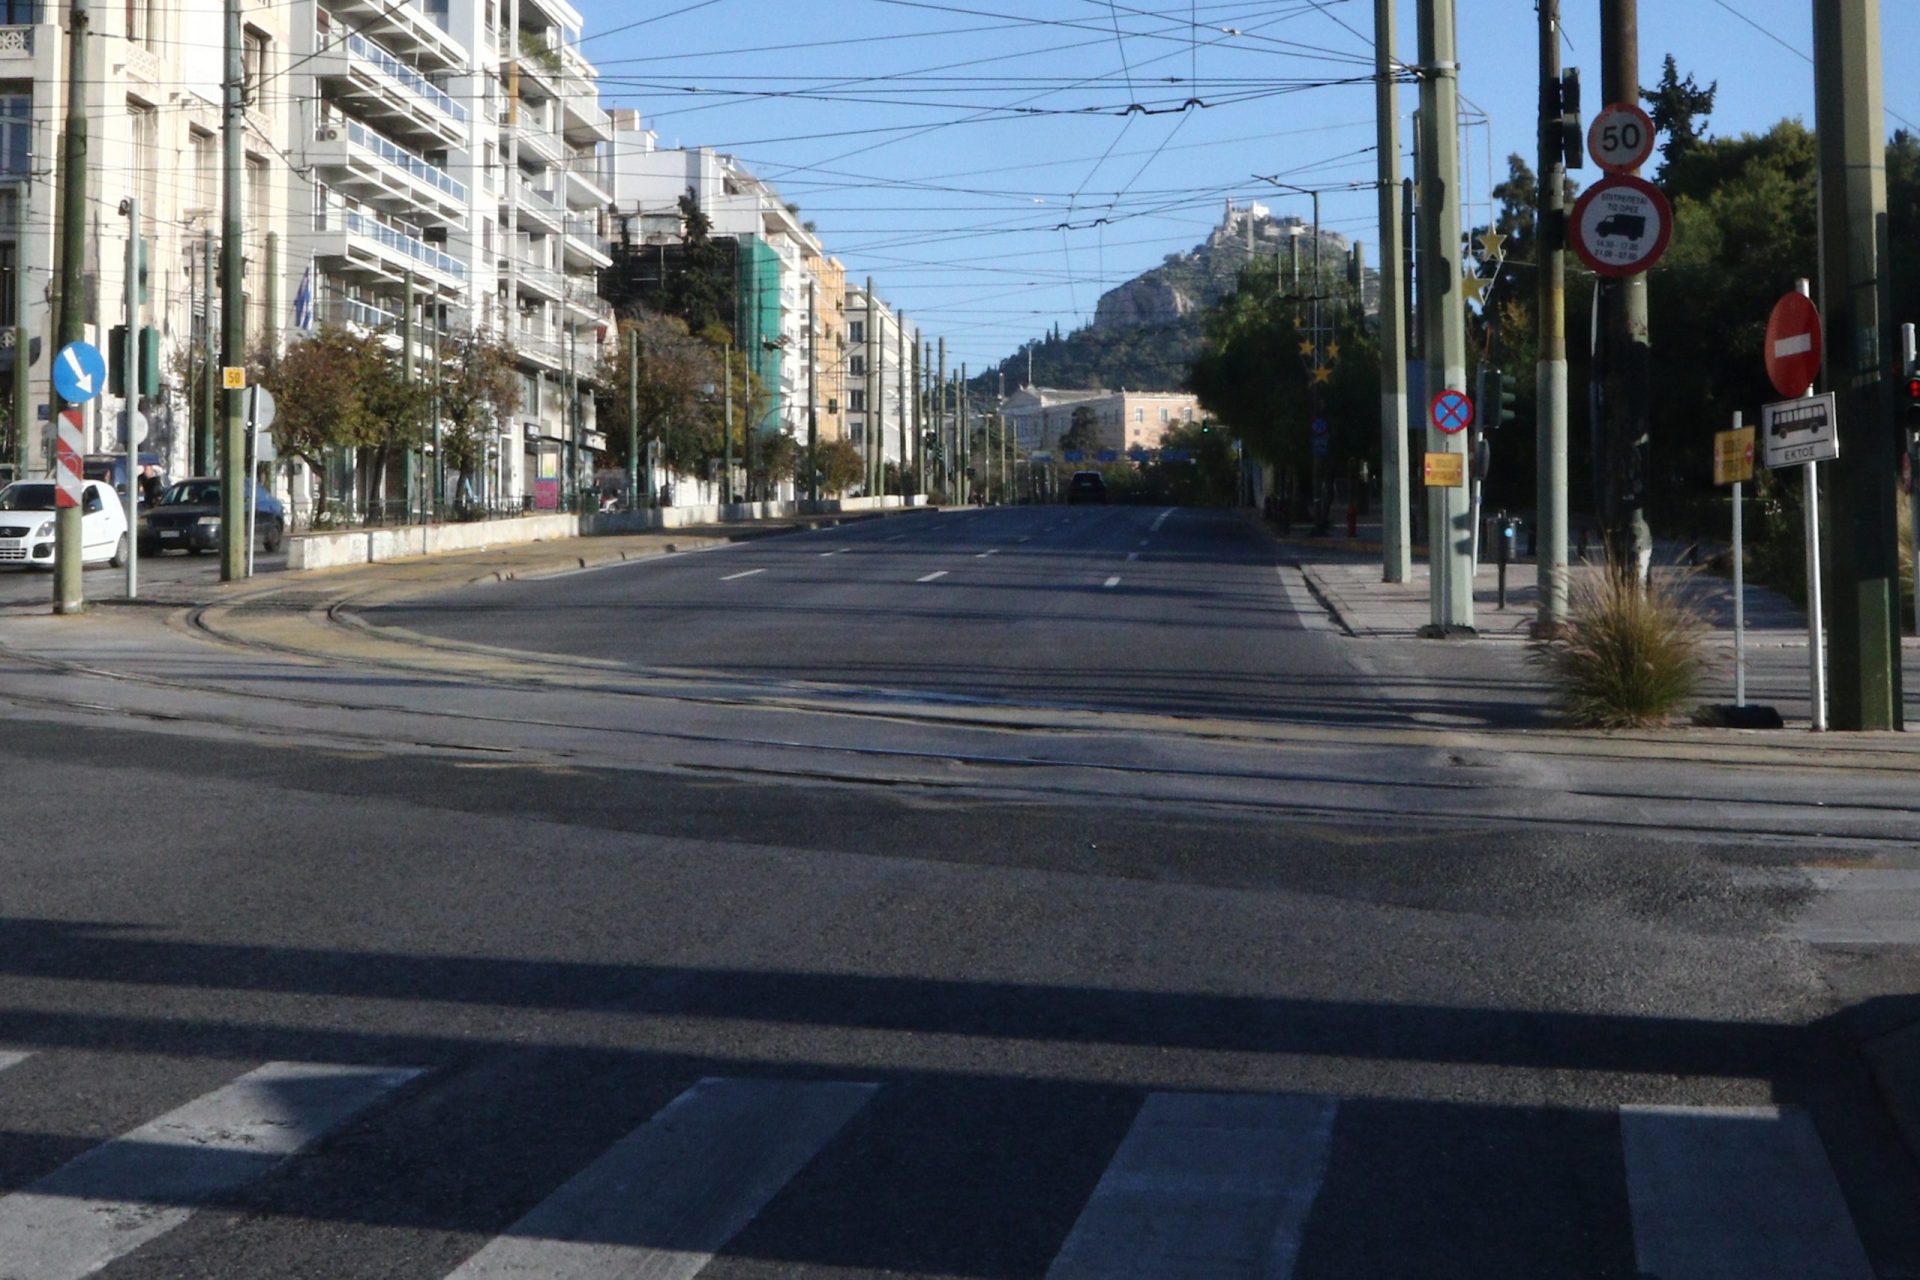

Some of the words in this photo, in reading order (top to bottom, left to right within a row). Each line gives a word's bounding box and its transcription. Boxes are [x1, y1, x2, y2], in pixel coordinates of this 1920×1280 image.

[1602, 123, 1640, 152] 50
[228, 371, 241, 384] 50
[1784, 446, 1816, 461] ΕΚΤΟΣ
